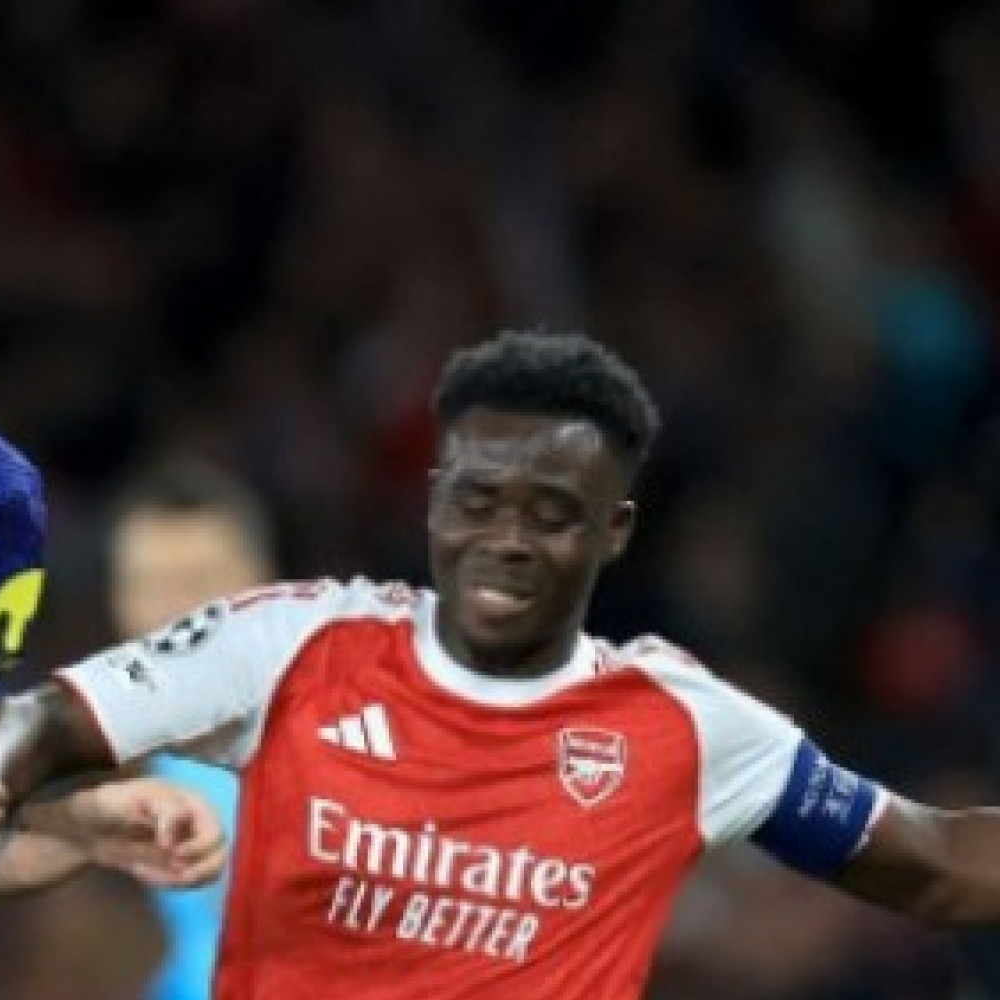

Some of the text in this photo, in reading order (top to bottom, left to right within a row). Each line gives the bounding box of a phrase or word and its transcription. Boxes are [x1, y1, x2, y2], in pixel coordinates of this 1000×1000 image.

[308, 795, 596, 909] Emirates
[327, 876, 540, 964] FLY BETTER
